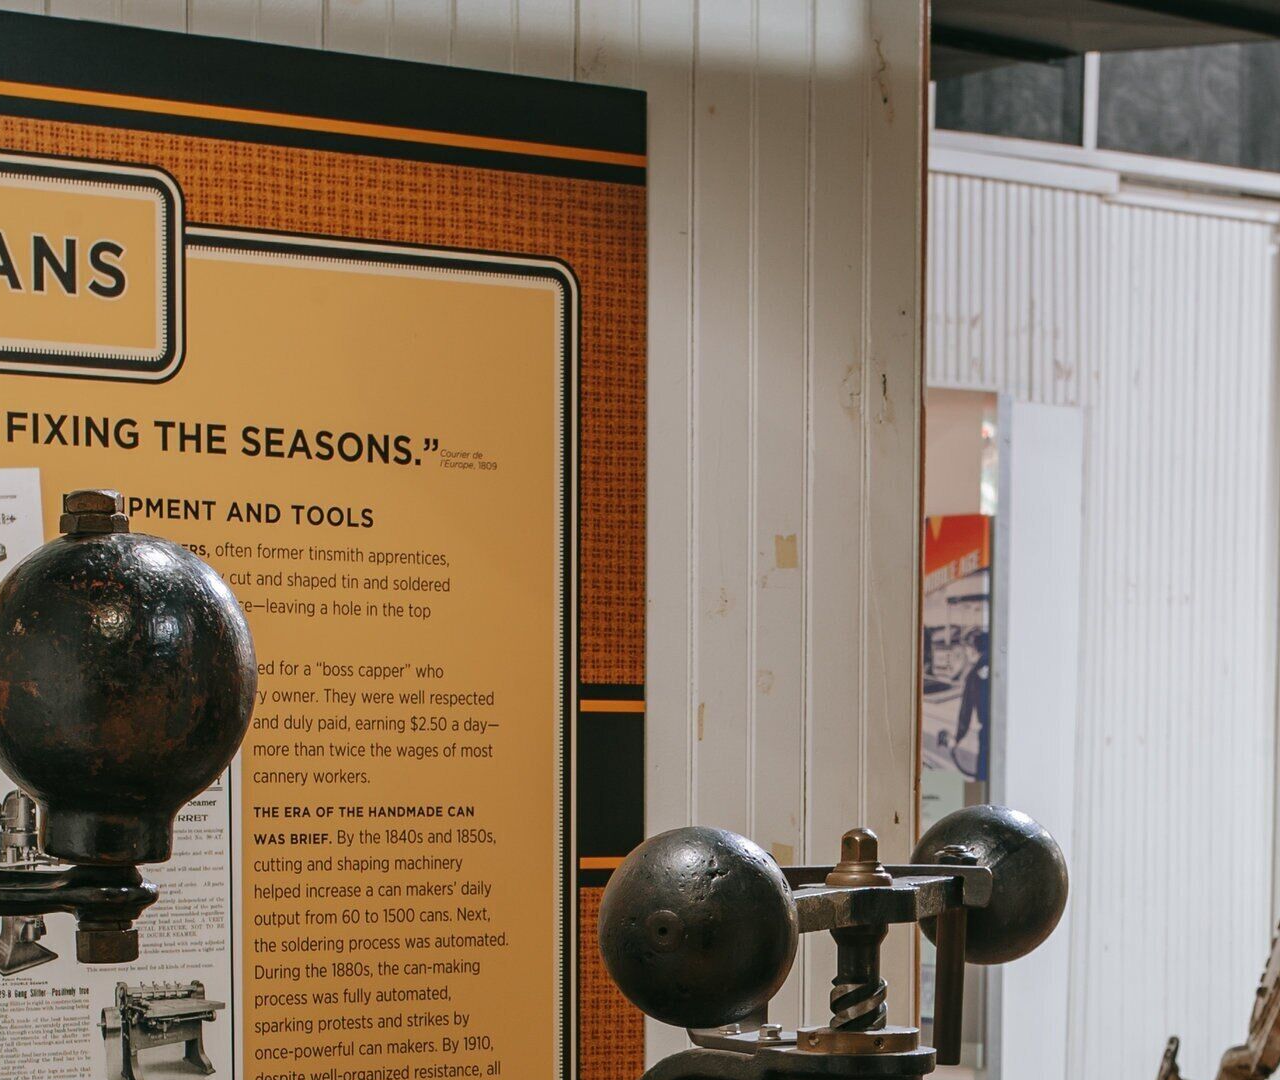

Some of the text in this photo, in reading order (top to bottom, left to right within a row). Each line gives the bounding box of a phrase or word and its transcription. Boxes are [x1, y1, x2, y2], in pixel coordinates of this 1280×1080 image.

[5, 410, 140, 450] FIXING
[152, 419, 227, 456] THE
[240, 428, 440, 467] SEASONS.”
[438, 457, 498, 471] l’Europe, 1809
[439, 447, 484, 460] Courier de
[225, 500, 281, 524] AND
[289, 503, 374, 529] TOOLS
[252, 713, 500, 735] and duly paid, earning $2.50 a day—
[252, 740, 494, 761] more than twice the wages of most
[252, 804, 475, 819] THE ERA OF THE HANDMADE CAN
[252, 827, 497, 848] WAS BRIEF. By the 1840s and 1850s,
